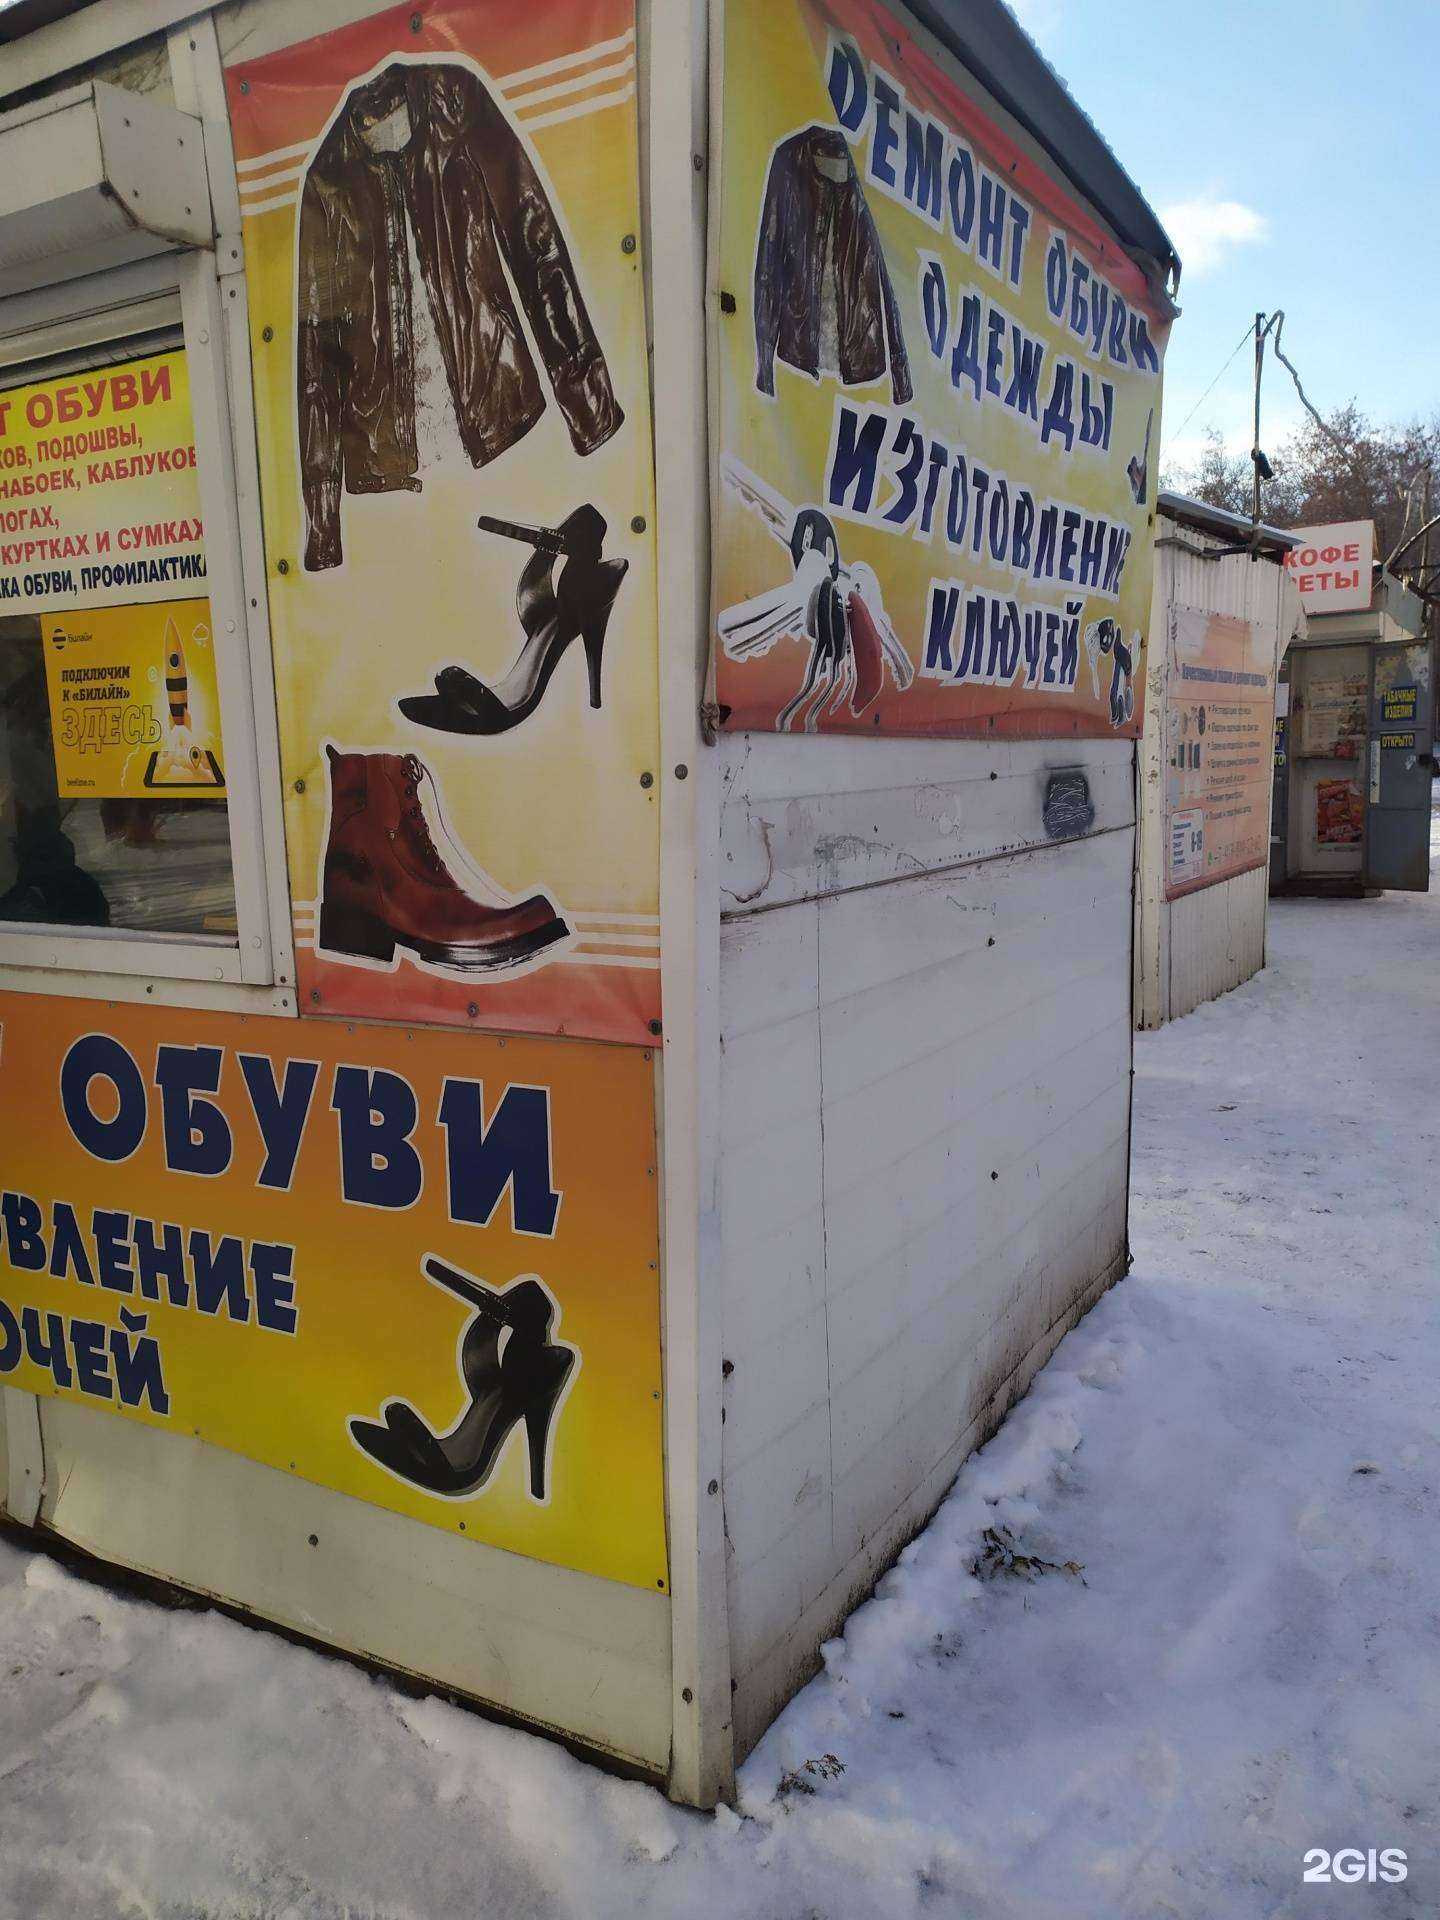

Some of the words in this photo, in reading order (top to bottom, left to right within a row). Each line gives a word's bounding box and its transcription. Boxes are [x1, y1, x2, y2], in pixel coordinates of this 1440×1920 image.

[1047, 236, 1159, 373] ОБУВИ
[922, 261, 1113, 452] ОДЕЖДЫ
[26, 365, 171, 428] ОБУВИ
[37, 423, 143, 462] ПОДОШВЫ,
[1, 534, 90, 566] КУРТКАХ
[96, 531, 111, 553] И
[117, 518, 203, 550] СУМКАХ
[1283, 544, 1359, 568] КОФЕ
[0, 577, 20, 598] КА
[24, 570, 77, 596] ОБУВИ,
[1292, 570, 1359, 592] ЕТЫ
[927, 586, 1082, 686] КЛЮЧЕЙ
[62, 666, 130, 684] ПОДКЛЮЧИМ
[63, 689, 70, 701] К
[72, 684, 130, 701] «БИЛАЙН»
[61, 705, 162, 754] ЗДЕСЬ
[1382, 735, 1414, 748] ОТКРЫТО
[60, 1032, 562, 1238] ОБУВИ
[0, 1192, 297, 1334] ВЛЕНИЕ
